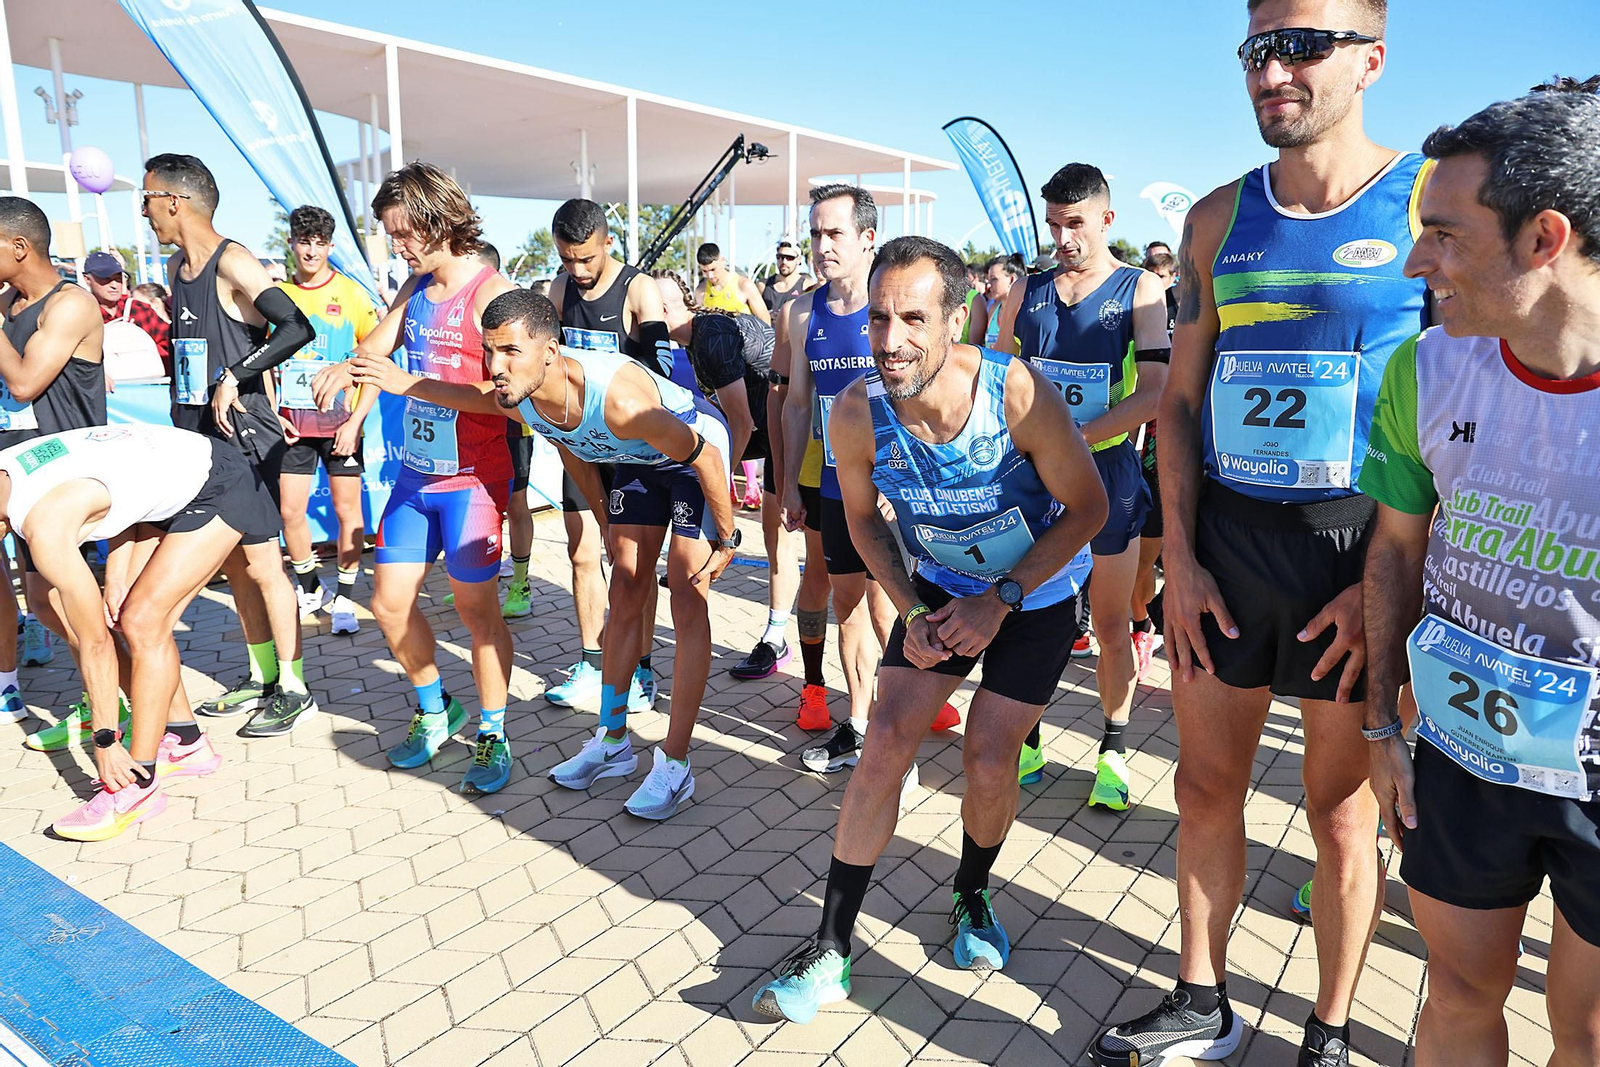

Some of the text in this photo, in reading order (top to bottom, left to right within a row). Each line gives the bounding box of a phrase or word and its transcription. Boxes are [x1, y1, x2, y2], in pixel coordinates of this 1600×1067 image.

[1221, 251, 1266, 265] ANAKY
[419, 324, 463, 342] lapalma
[809, 355, 876, 372] TROTASIERR
[1060, 368, 1087, 377] AVATEL
[1235, 360, 1263, 372] HUELVA
[1266, 362, 1315, 374] AVATEL
[1242, 387, 1307, 429] 22
[412, 418, 435, 442] 25
[1253, 449, 1289, 457] FERNANDES
[888, 460, 908, 469] BY2
[1230, 456, 1289, 476] Wayalia
[1467, 464, 1549, 496] Club Trail
[900, 483, 1004, 502] CLUB ONUBENSE
[911, 496, 1000, 516] DE ATLETISMO
[1484, 495, 1534, 526] Trail
[933, 533, 958, 542] HUELVA
[959, 525, 995, 542] AVATEL
[963, 544, 987, 565] 1
[1505, 527, 1600, 580] Abu
[1451, 599, 1546, 657] Abuela
[1438, 632, 1472, 659] HUELVA
[1474, 653, 1532, 684] AVATEL
[1534, 668, 1577, 697] '24
[1507, 676, 1532, 688] TELECOM
[1447, 671, 1519, 736] 26
[1457, 725, 1505, 753] JUAN ENRIQUE
[1435, 726, 1505, 775] Wayalia
